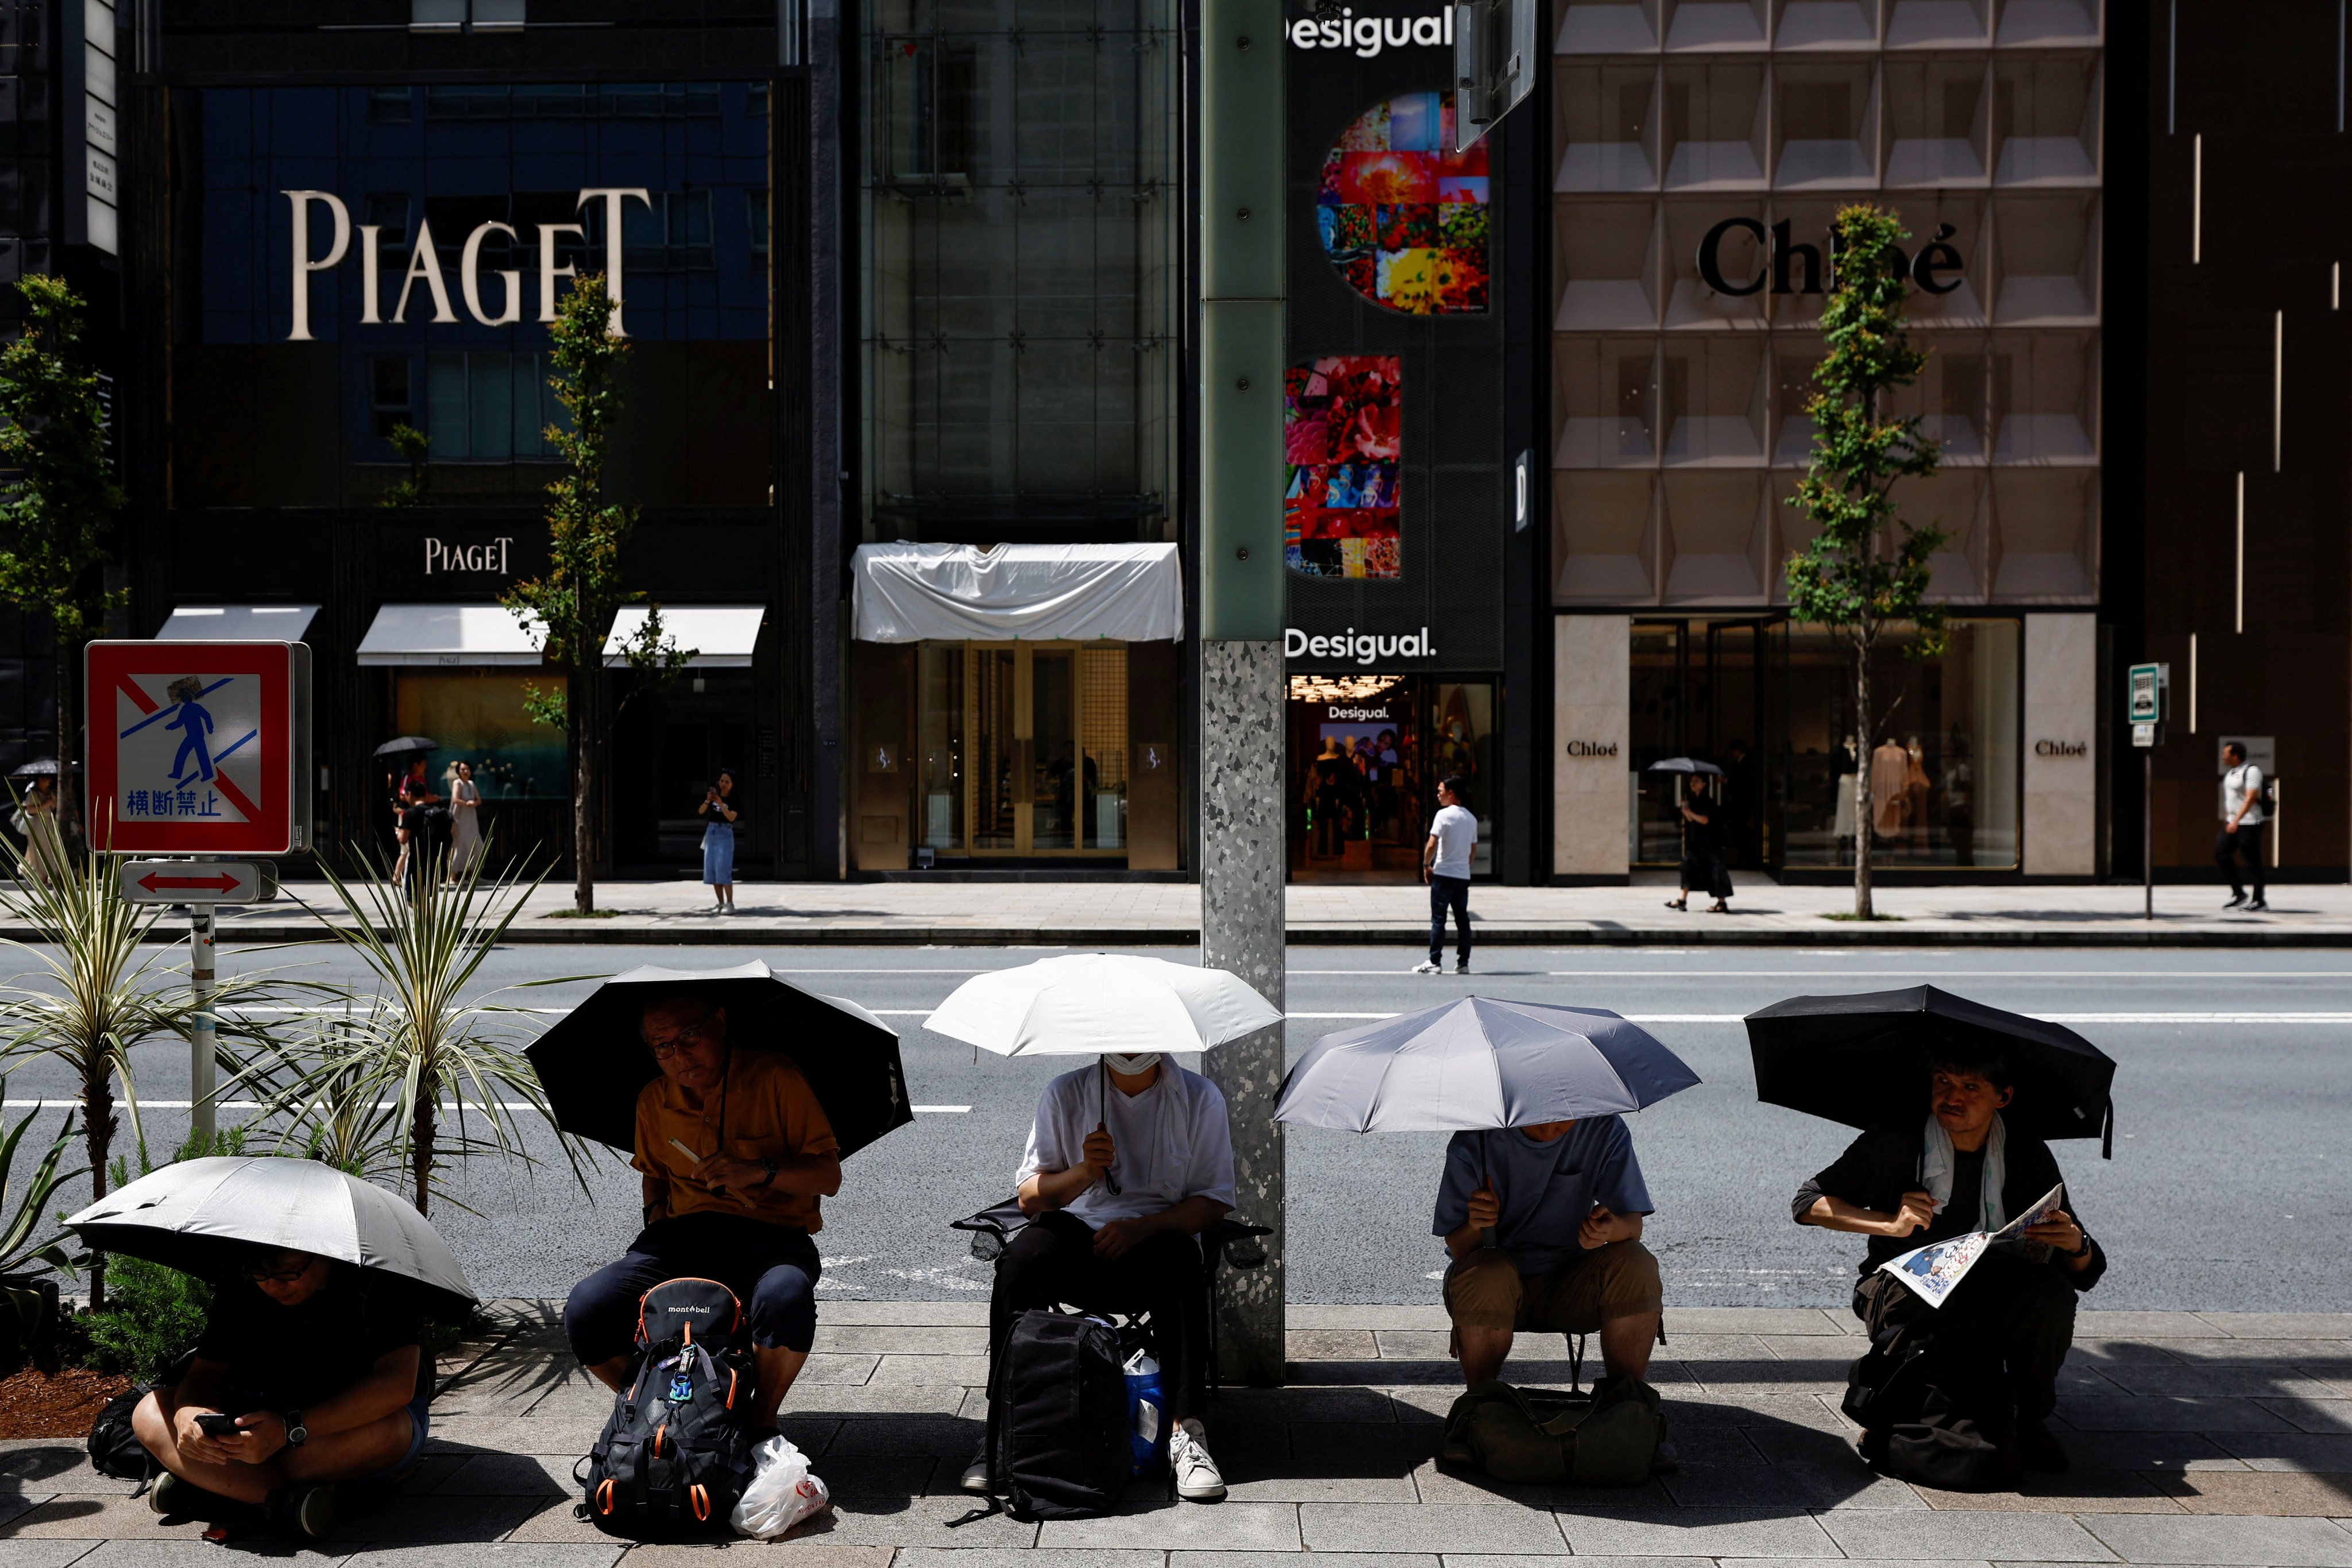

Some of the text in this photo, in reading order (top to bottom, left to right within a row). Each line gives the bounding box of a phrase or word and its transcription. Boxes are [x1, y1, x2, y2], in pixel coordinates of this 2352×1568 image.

[1286, 5, 1453, 57] esigual
[280, 187, 654, 341] PIAGET
[425, 537, 513, 574] PIAGET
[1285, 627, 1436, 665] Desigual.
[1328, 706, 1389, 721] Desigual.
[1567, 740, 1618, 756] Chloé
[2035, 739, 2087, 757] Chloé
[126, 790, 222, 816] 横断禁止
